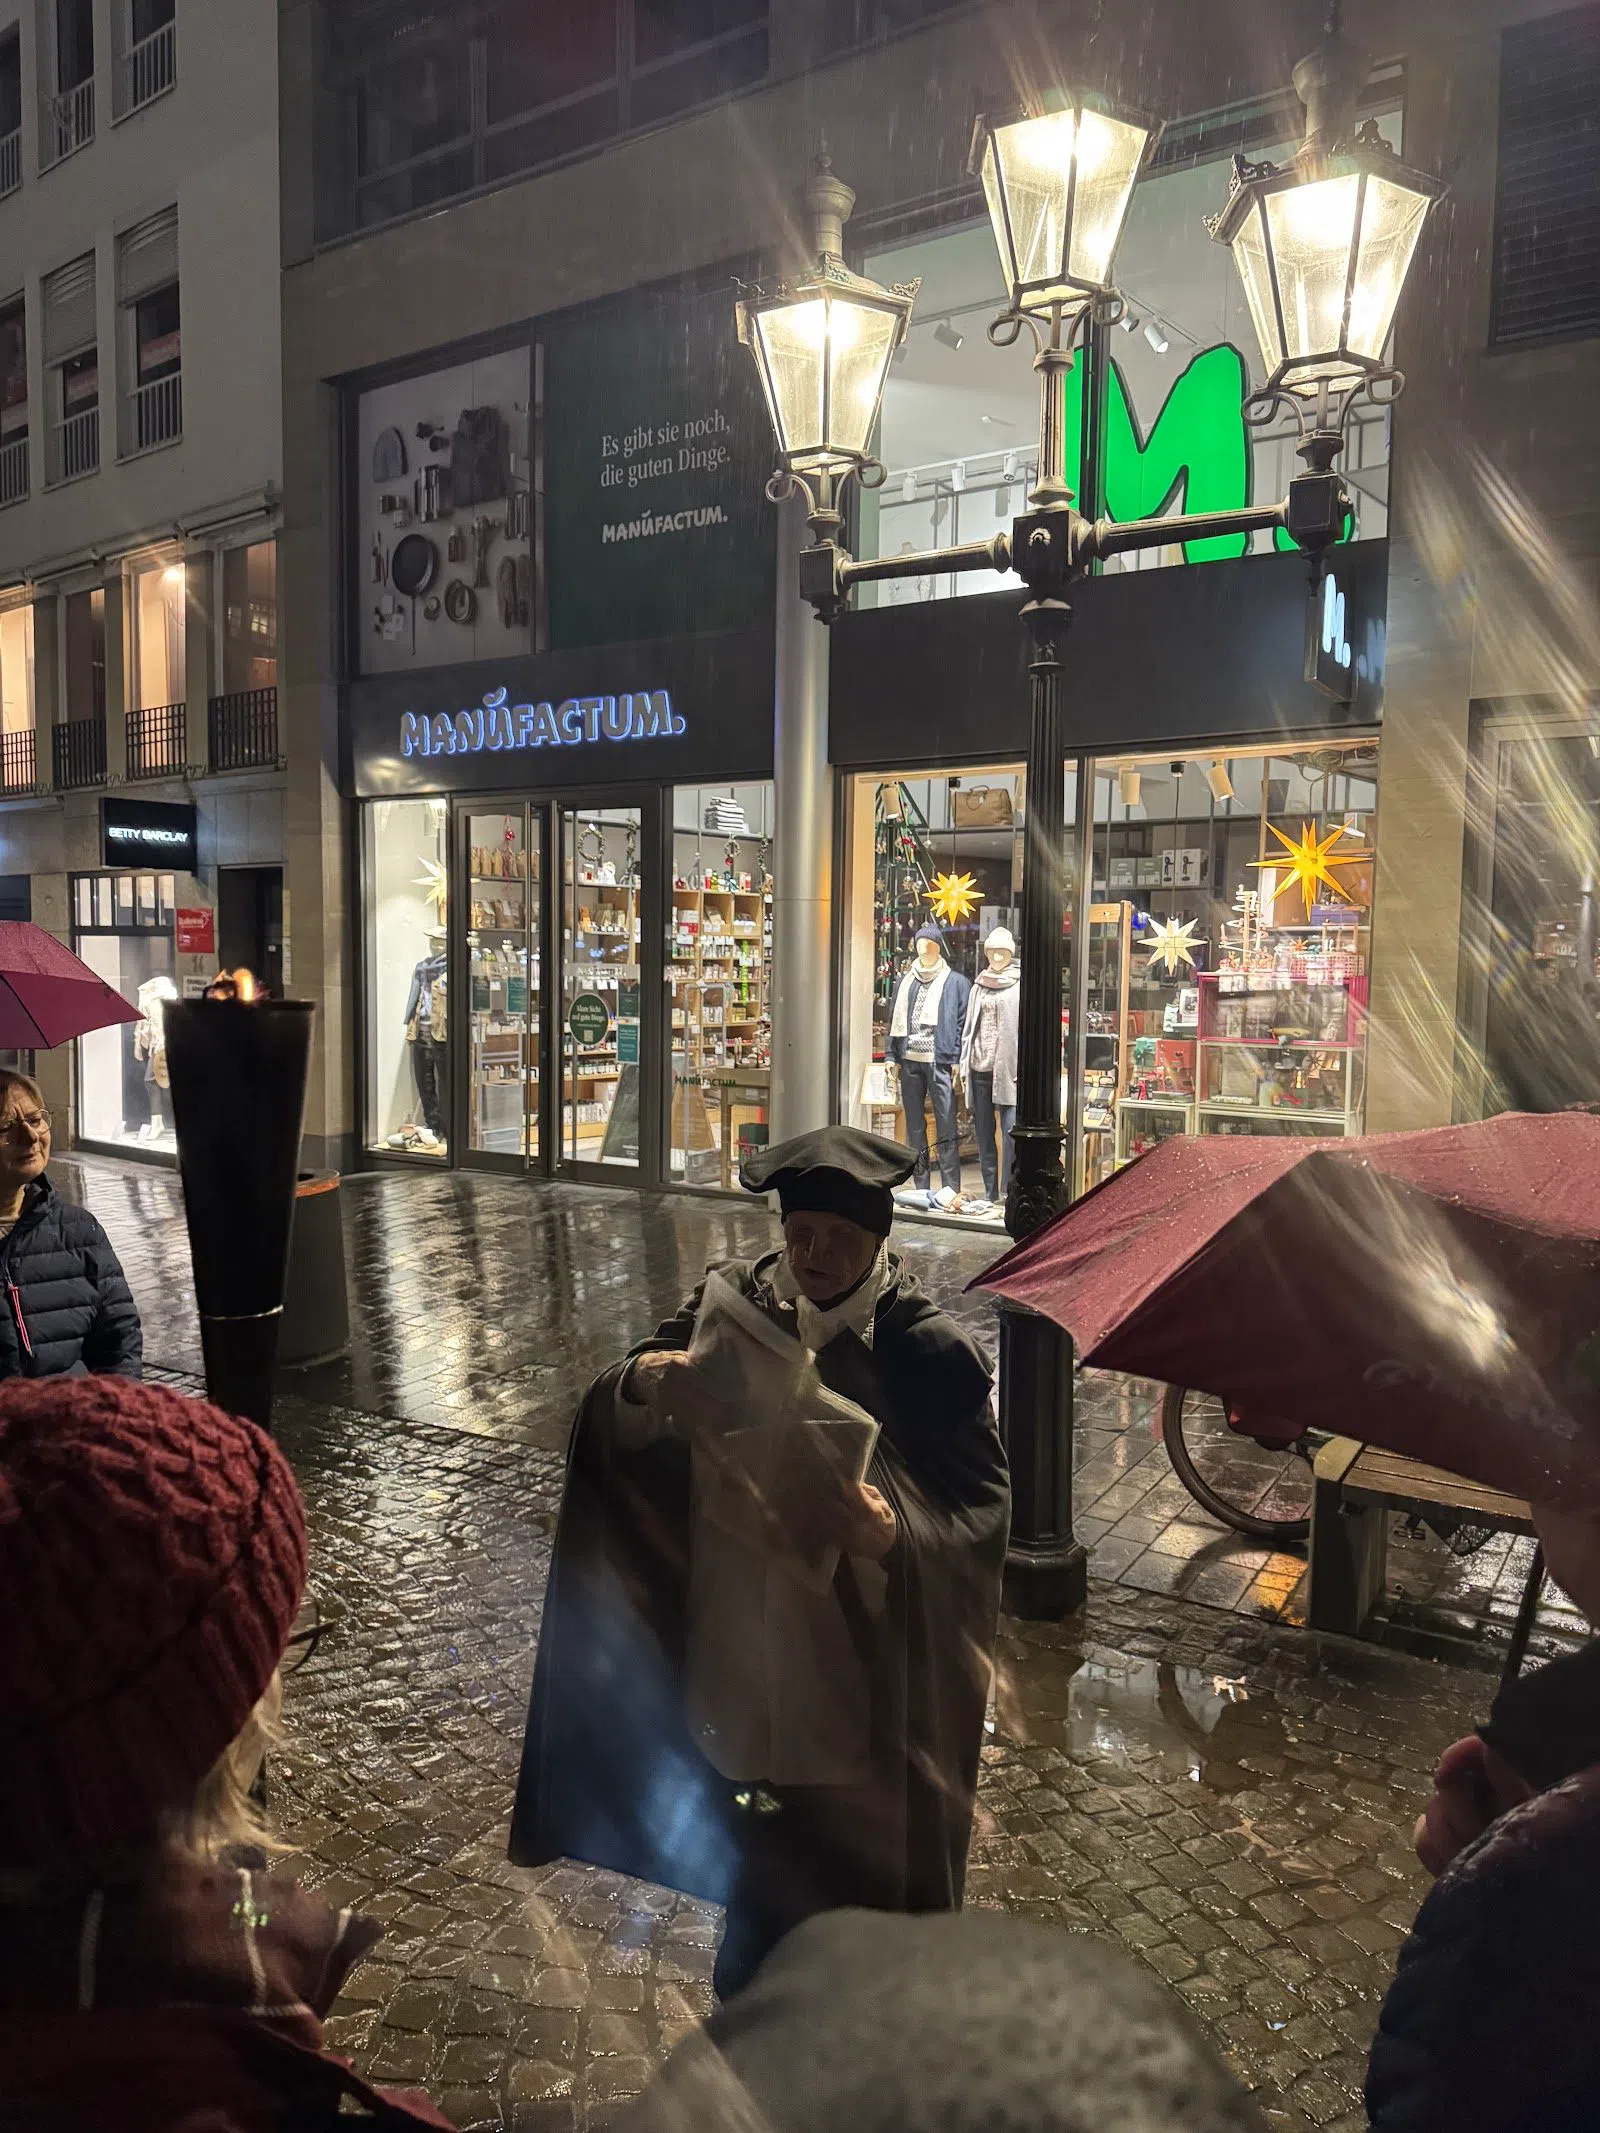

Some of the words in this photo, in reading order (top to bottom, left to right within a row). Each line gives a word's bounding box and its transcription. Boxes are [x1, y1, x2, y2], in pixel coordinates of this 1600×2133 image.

[602, 435, 619, 457] Es
[623, 426, 654, 458] gibt
[657, 422, 680, 445] sie
[684, 408, 731, 439] noch,
[600, 463, 624, 487] die
[628, 458, 673, 488] guten
[678, 446, 731, 472] Dinge.
[108, 827, 141, 840] BETTY
[142, 829, 188, 842] BARCLAY
